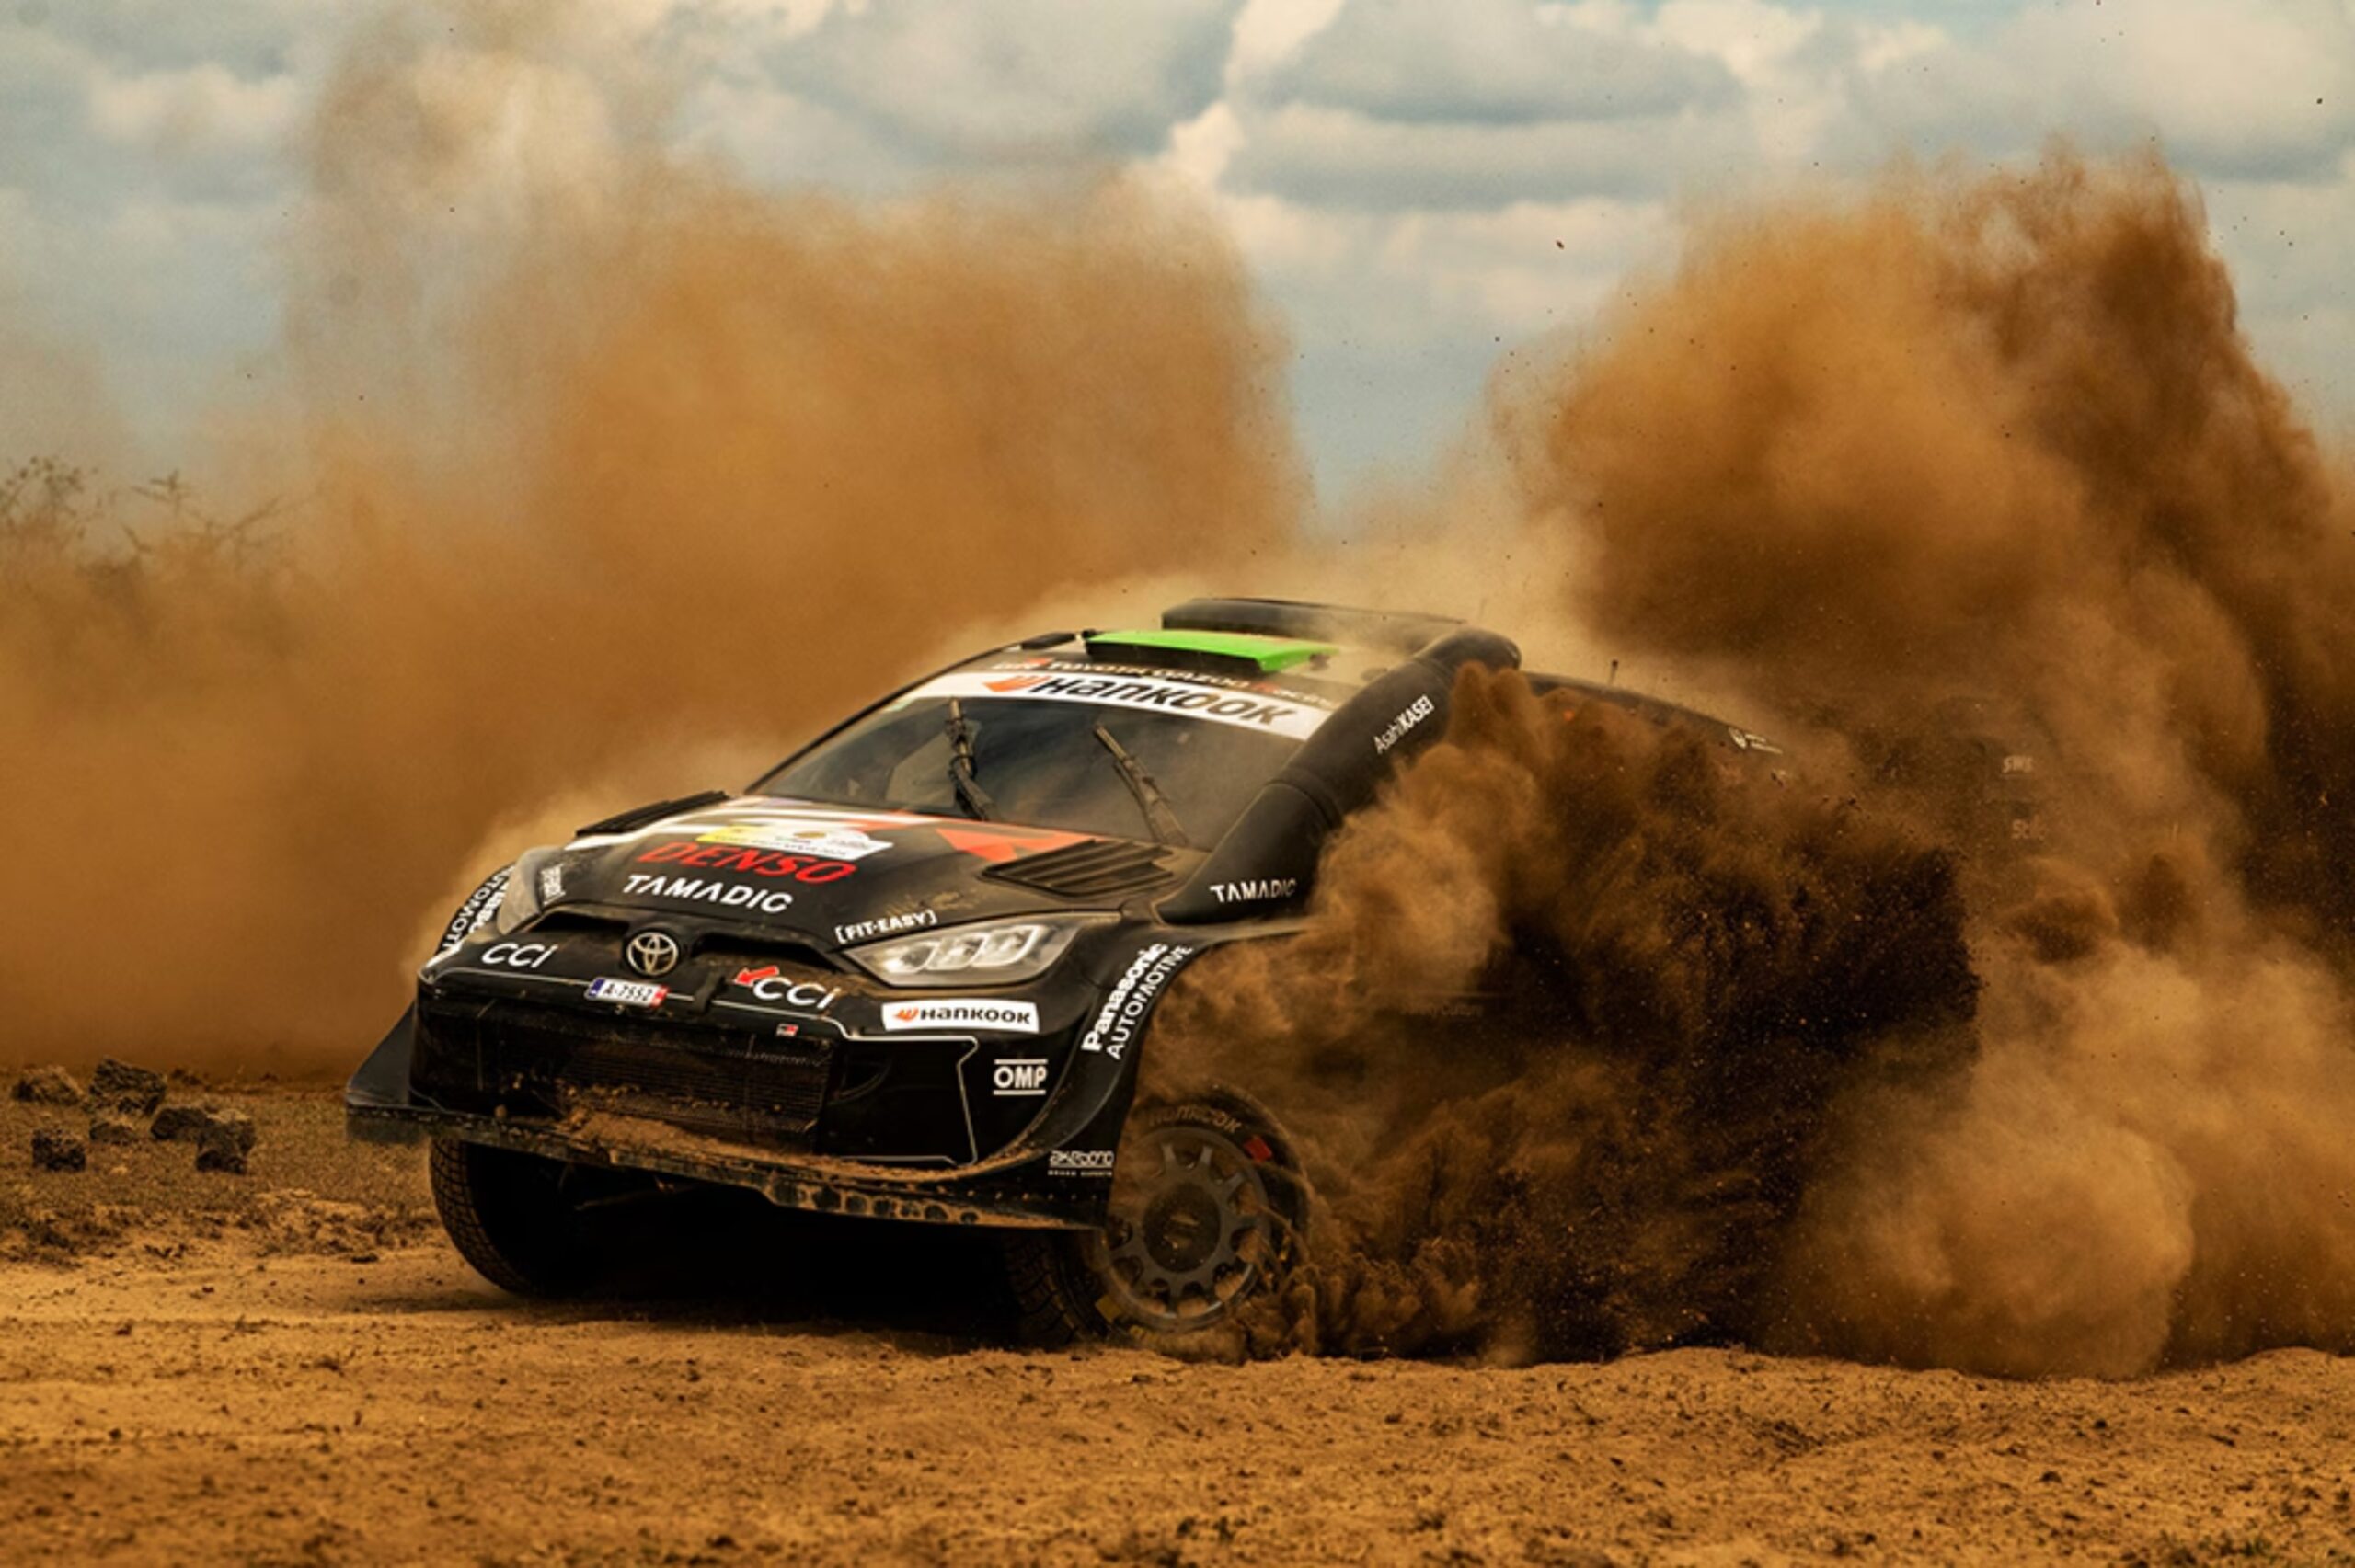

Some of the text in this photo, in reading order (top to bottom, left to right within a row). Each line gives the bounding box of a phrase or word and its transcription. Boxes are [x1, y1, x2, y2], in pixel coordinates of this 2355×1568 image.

[637, 841, 856, 884] DENSO
[622, 875, 794, 913] TAMADIC
[1209, 877, 1297, 903] TAMADIC
[481, 943, 559, 968] CCI
[752, 976, 842, 1010] CCI
[1081, 944, 1169, 1051] Panasonic
[1106, 945, 1193, 1060] AUTOMOTIVE
[994, 1065, 1048, 1089] OMP
